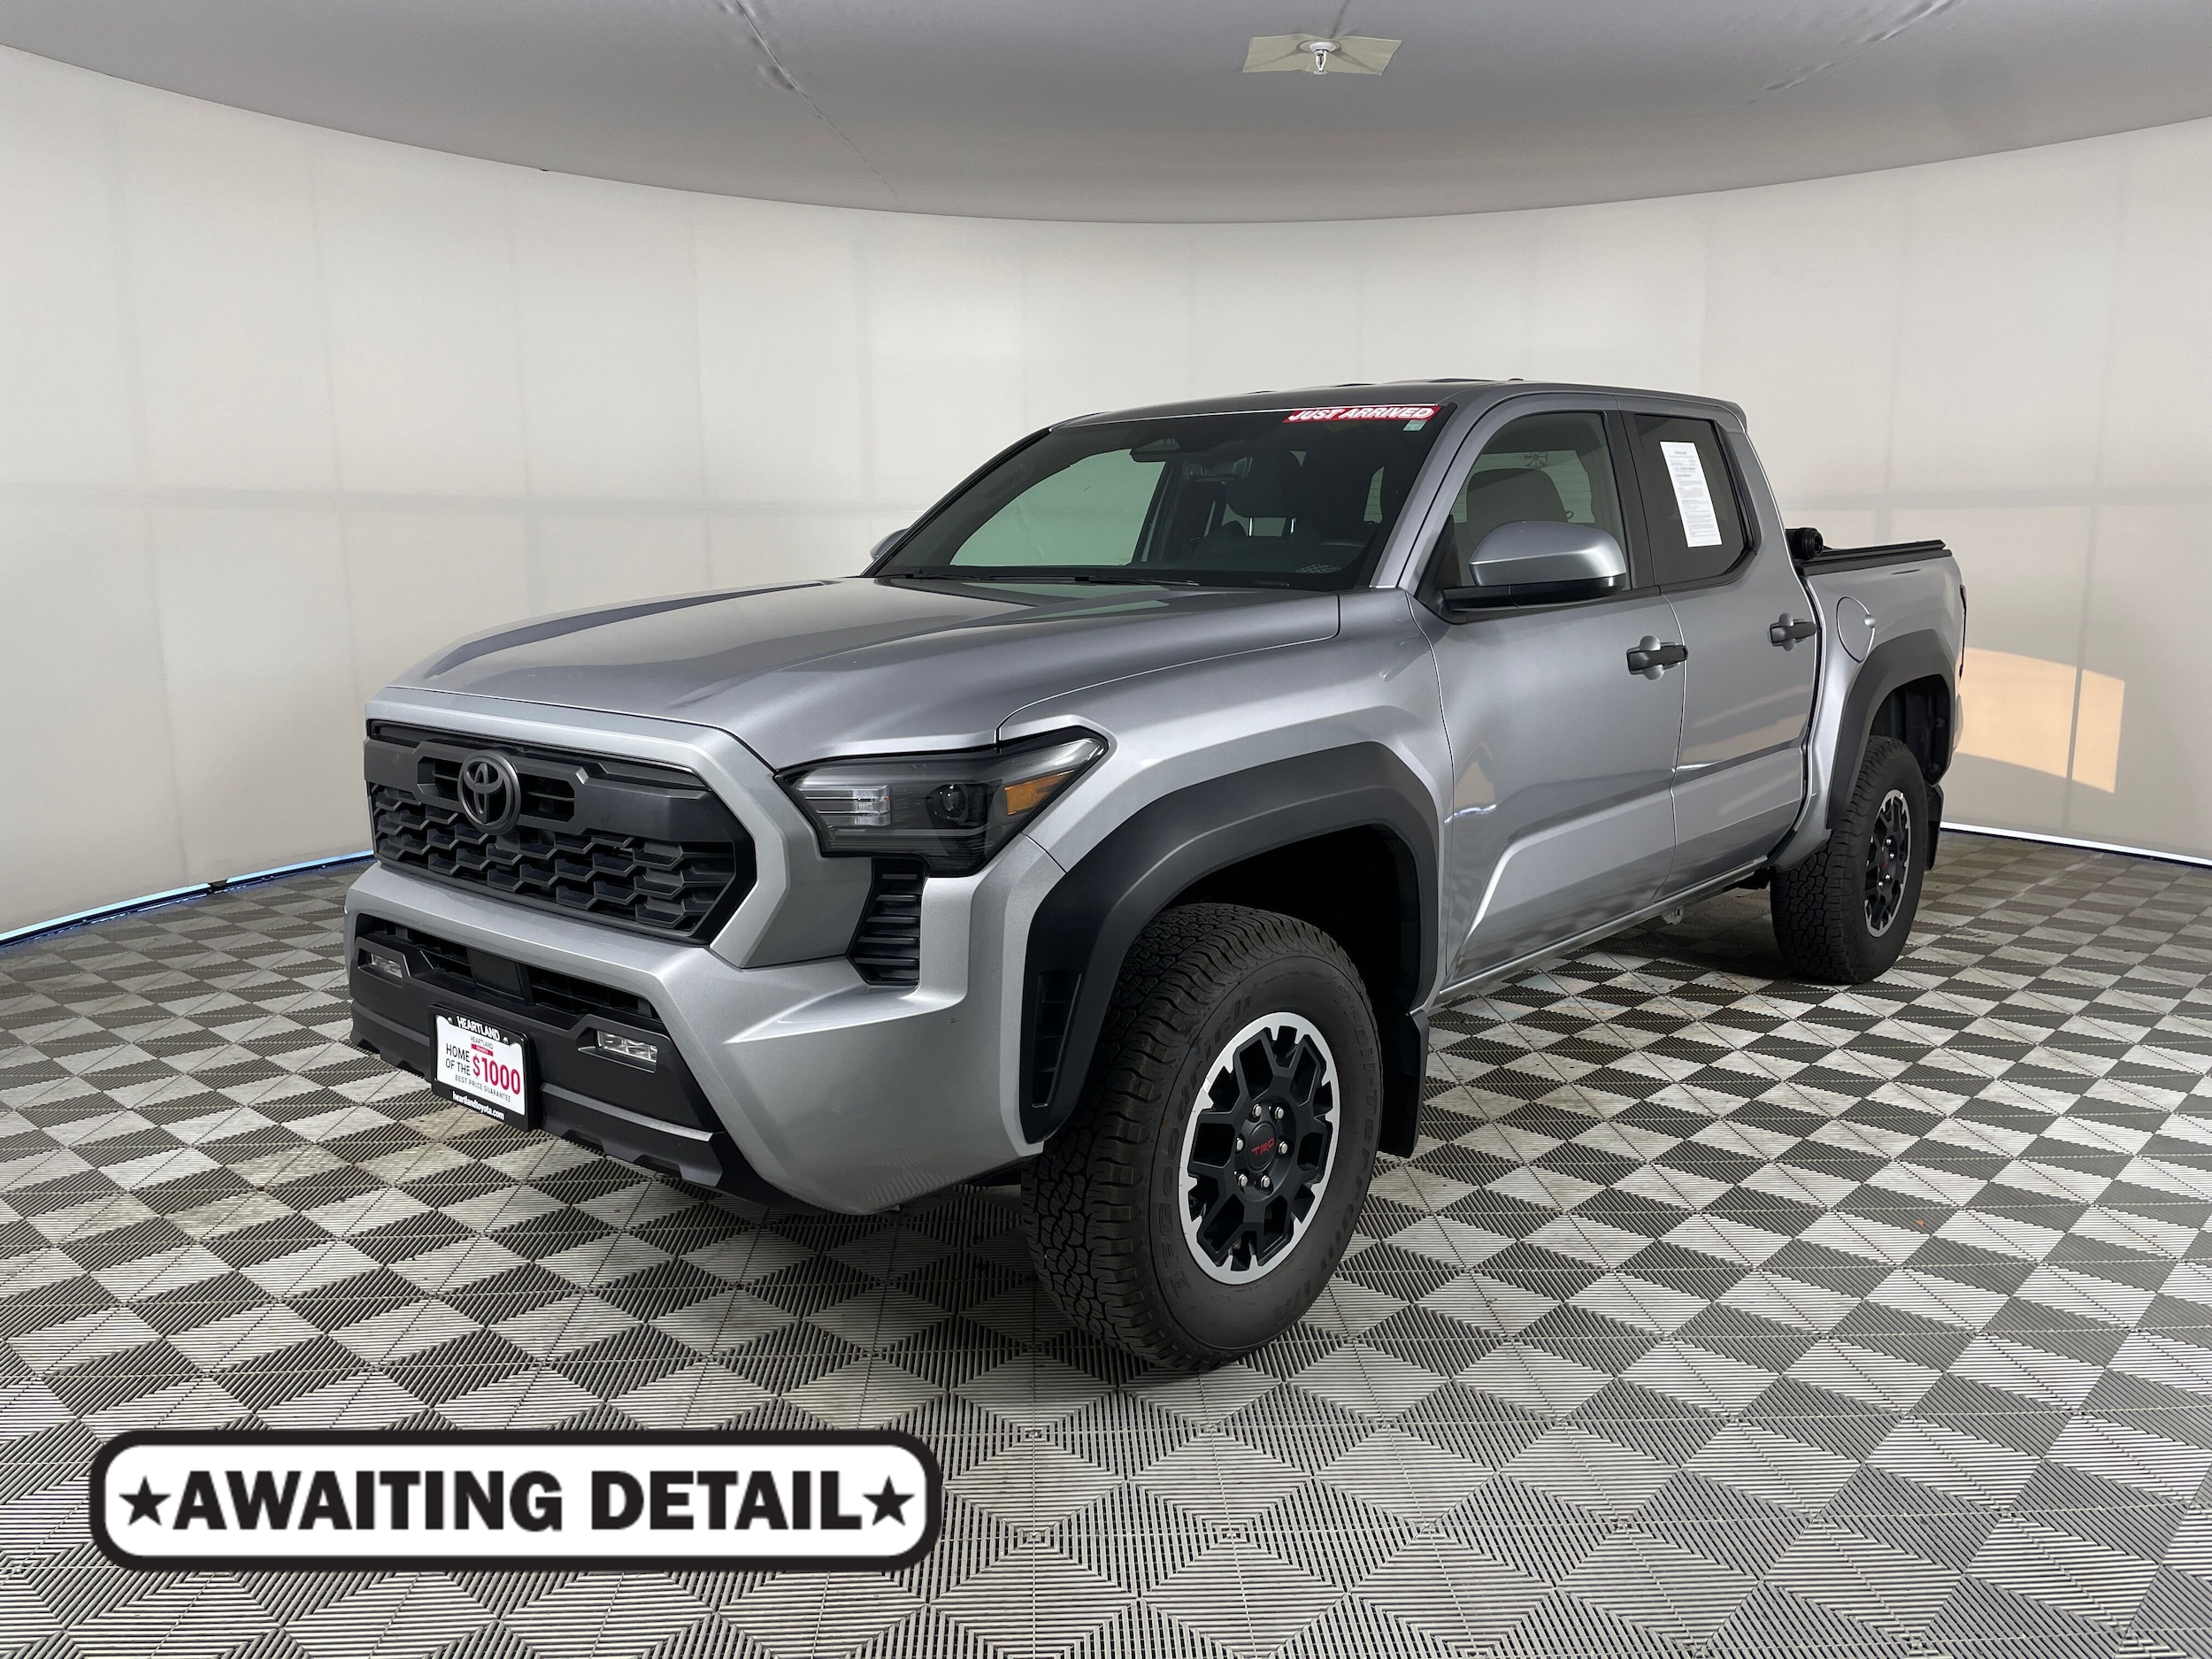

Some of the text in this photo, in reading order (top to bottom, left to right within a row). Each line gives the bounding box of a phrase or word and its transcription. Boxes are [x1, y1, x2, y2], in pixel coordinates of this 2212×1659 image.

[1288, 407, 1435, 420] JUST ARRIVED
[457, 1016, 501, 1041] HEARTLAND
[446, 1043, 470, 1063] HOME
[471, 1035, 494, 1050] HEARTLAND
[445, 1054, 520, 1095] OF THE $1000
[455, 1074, 511, 1102] BEST PRICE GUARANTEE
[452, 1091, 504, 1120] heartlandtoyota.com
[1251, 1138, 1274, 1156] TRD
